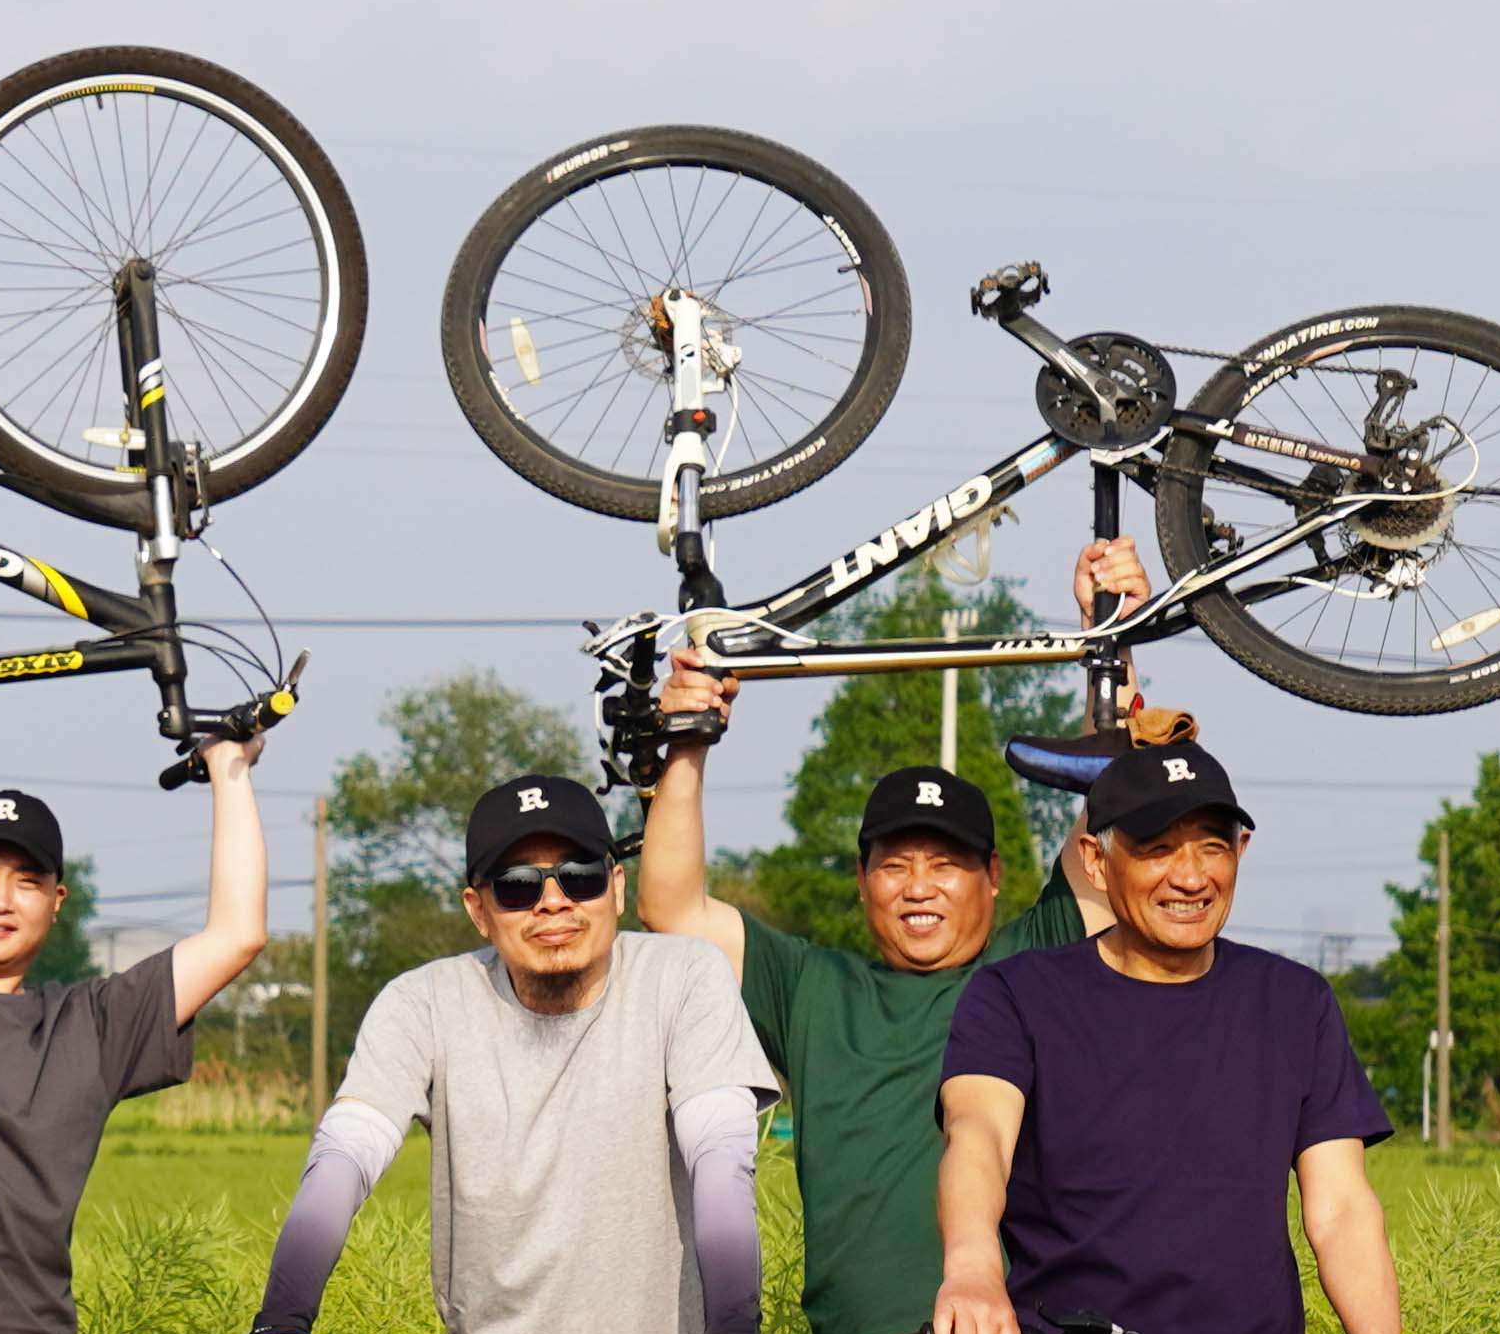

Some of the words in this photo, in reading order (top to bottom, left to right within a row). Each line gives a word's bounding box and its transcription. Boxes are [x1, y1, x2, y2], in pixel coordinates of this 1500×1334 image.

[824, 475, 992, 598] GIANT
[1162, 758, 1196, 783] R
[517, 787, 549, 813] R
[915, 781, 944, 806] R
